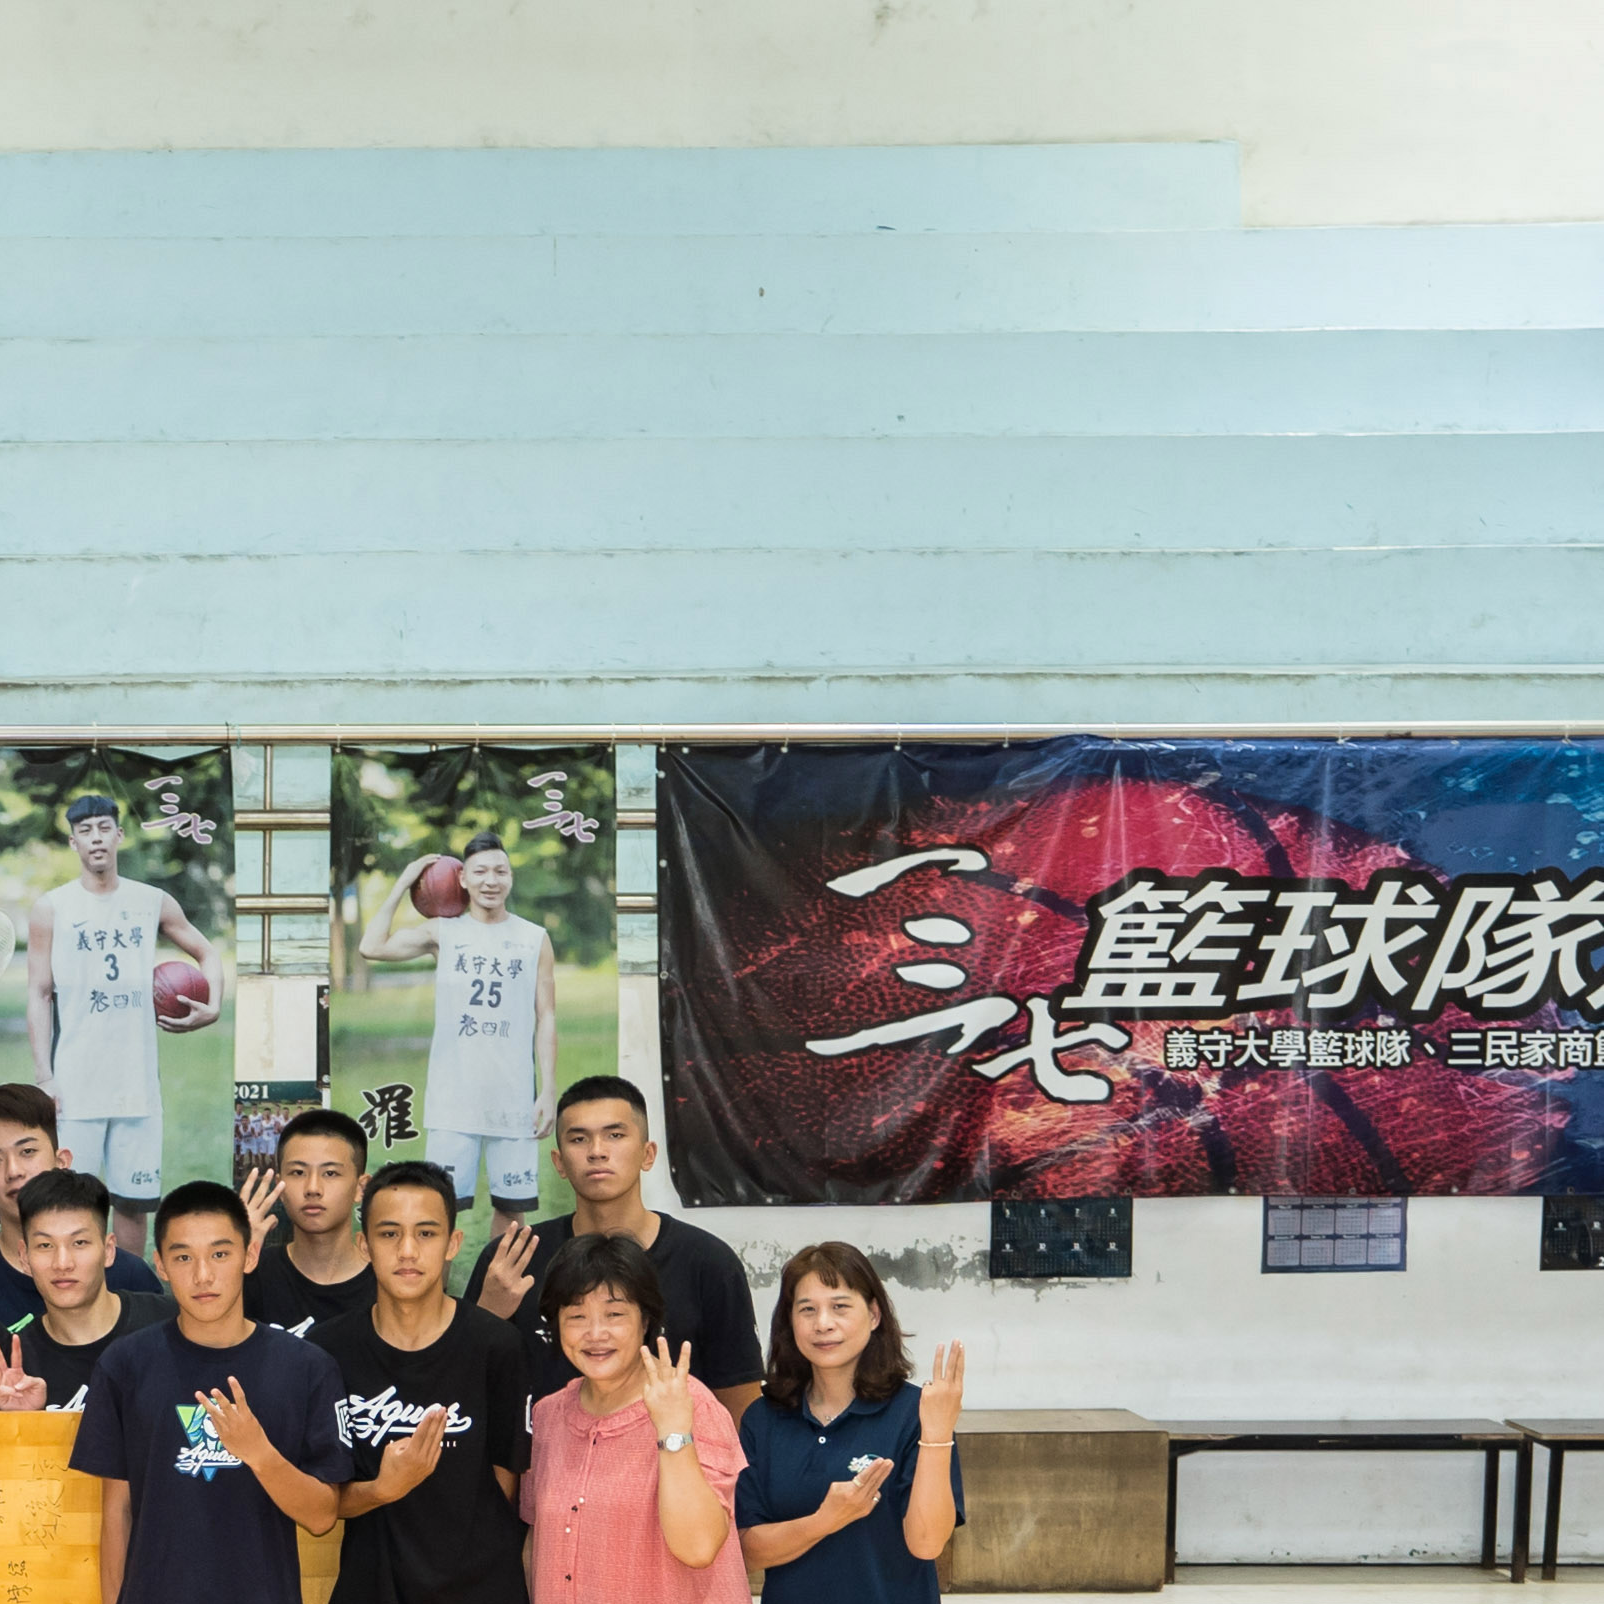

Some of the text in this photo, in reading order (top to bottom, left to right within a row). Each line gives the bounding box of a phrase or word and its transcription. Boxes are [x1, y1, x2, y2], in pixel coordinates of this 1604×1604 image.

[75, 925, 145, 952] 義守大學
[1061, 880, 1604, 1012] 籃球隊
[105, 953, 120, 981] 3
[454, 952, 523, 979] 義守大學
[469, 978, 502, 1008] 25
[234, 1084, 269, 1099] 2021
